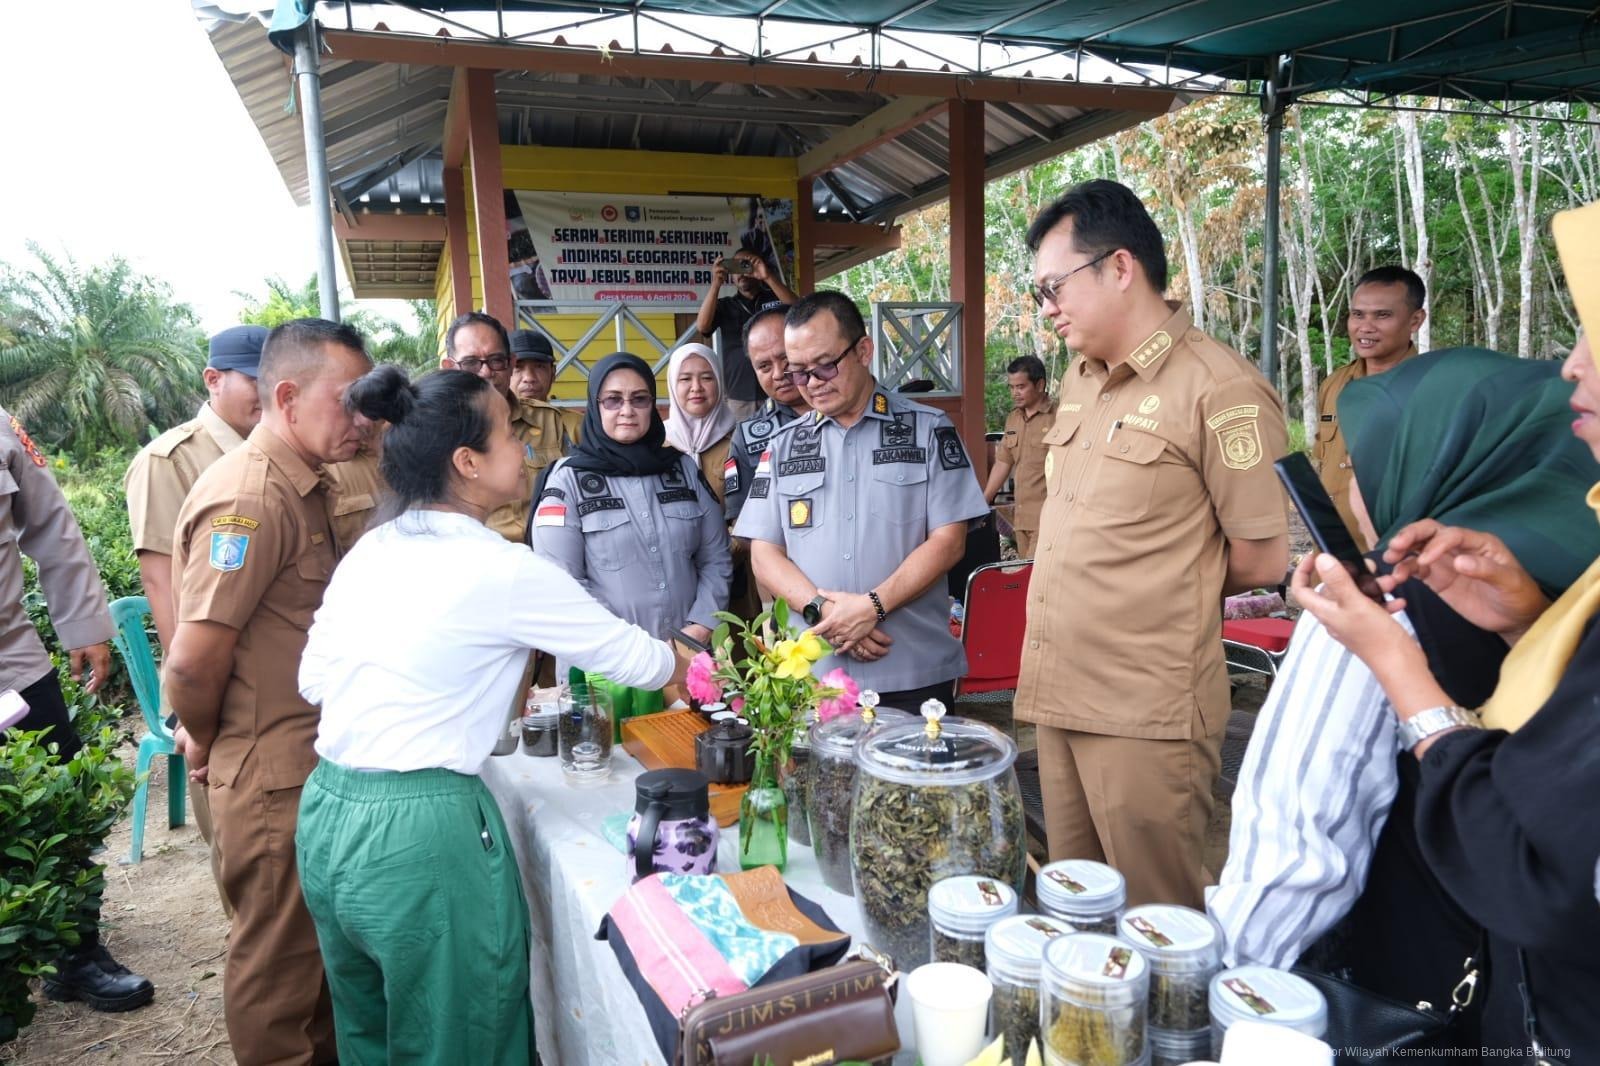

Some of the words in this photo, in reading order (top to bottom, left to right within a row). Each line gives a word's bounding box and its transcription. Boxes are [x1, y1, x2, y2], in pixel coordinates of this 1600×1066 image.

[554, 228, 598, 242] SERAH
[603, 229, 655, 243] TERIMA
[659, 230, 728, 244] SERTIFIKAT
[562, 249, 621, 263] INDIKASI
[627, 250, 697, 264] GEOGRAFIS
[551, 269, 587, 283] TAYU
[591, 269, 630, 283] JEBUS
[636, 270, 689, 284] BANGKA
[780, 461, 821, 475] JOHAN
